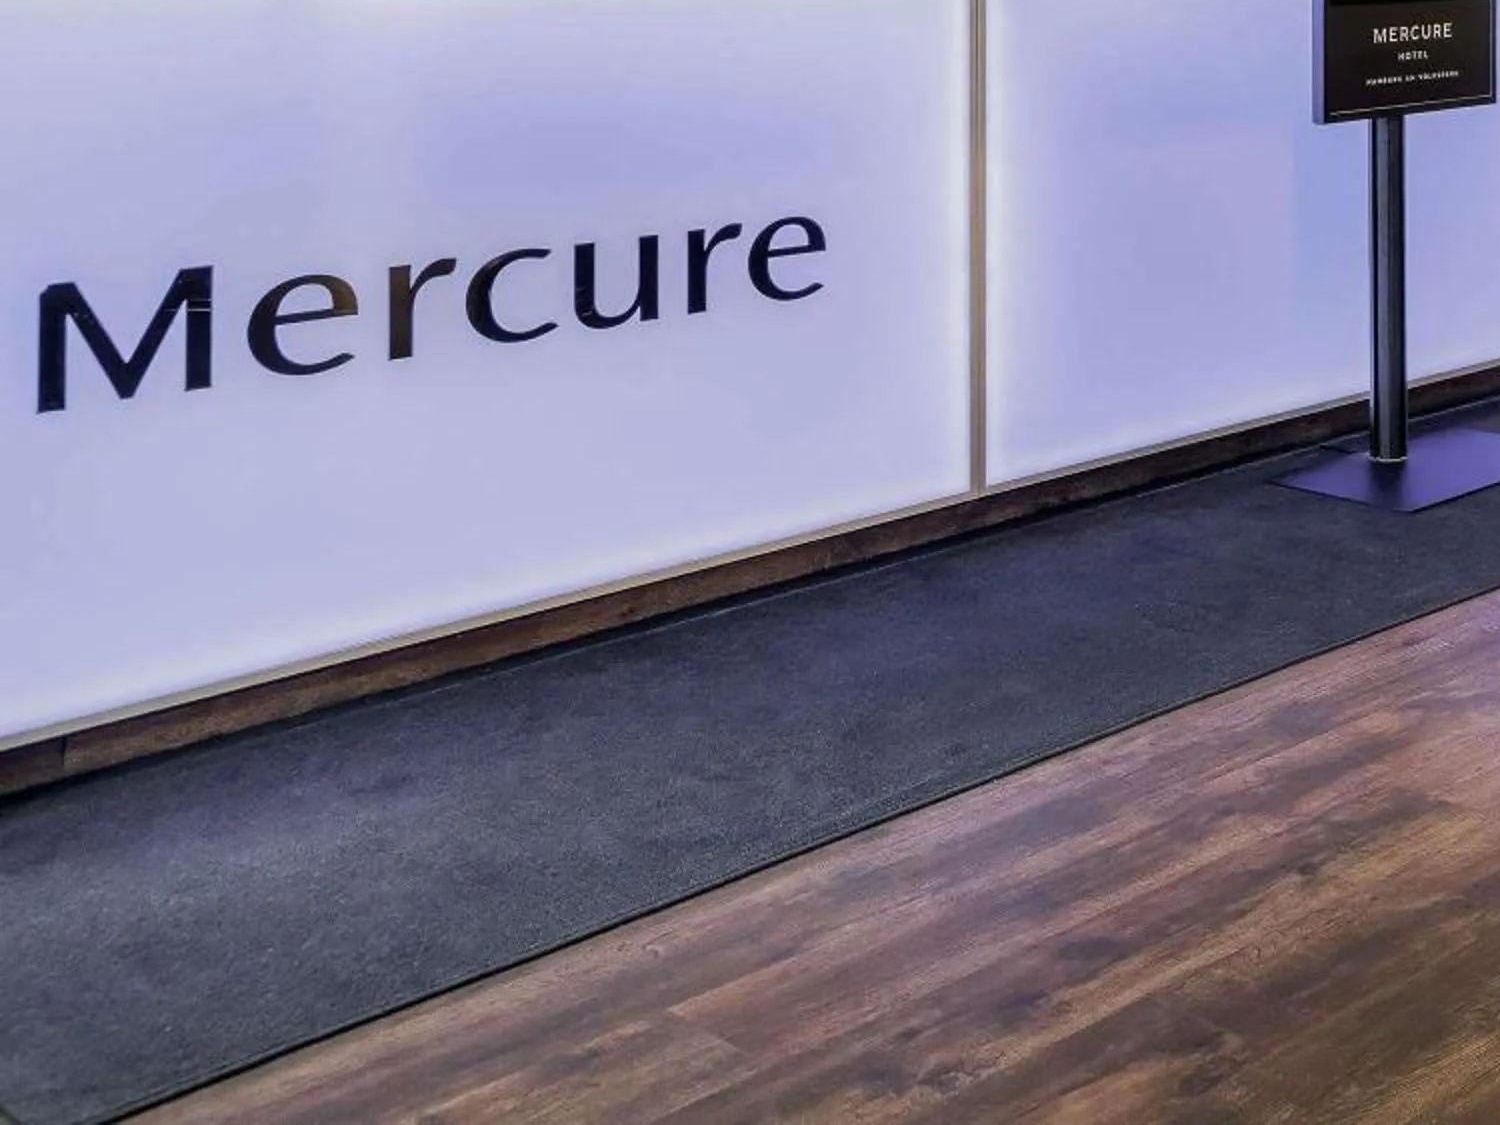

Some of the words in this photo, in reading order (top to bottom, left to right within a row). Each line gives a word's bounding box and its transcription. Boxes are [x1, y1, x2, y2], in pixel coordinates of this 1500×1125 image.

[1373, 22, 1453, 44] MERCURE
[1397, 50, 1429, 62] HOTEL
[37, 216, 827, 413] Mercure
